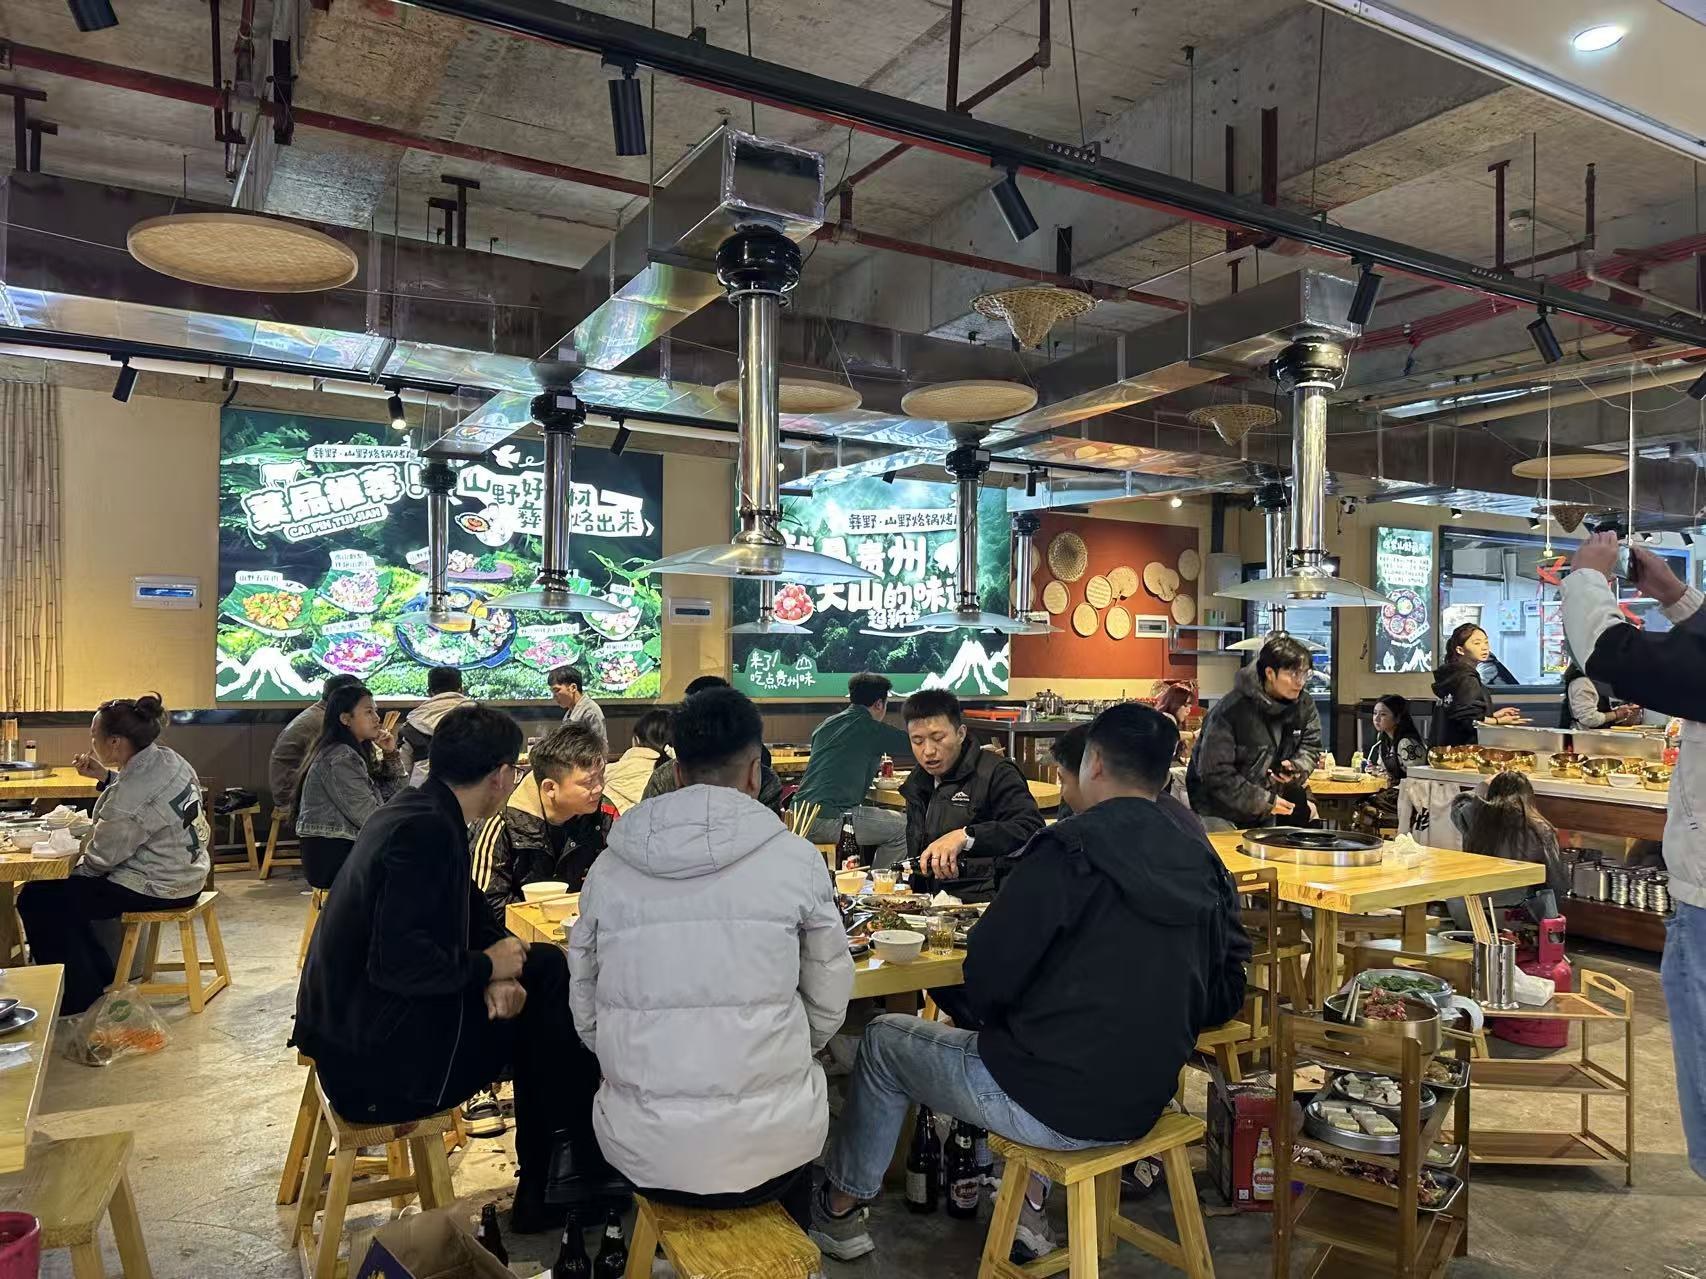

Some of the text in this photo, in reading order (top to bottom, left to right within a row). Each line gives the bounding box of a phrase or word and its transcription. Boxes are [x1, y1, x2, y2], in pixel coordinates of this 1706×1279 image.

[463, 472, 592, 505] 山野好材
[289, 507, 382, 538] CAI PIN TUI JIAN
[518, 503, 638, 533] 彝烙出来
[849, 513, 957, 529] 彝野·山野烙锅烤
[750, 651, 779, 671] 来了!
[750, 669, 816, 690] 吃点贵州味
